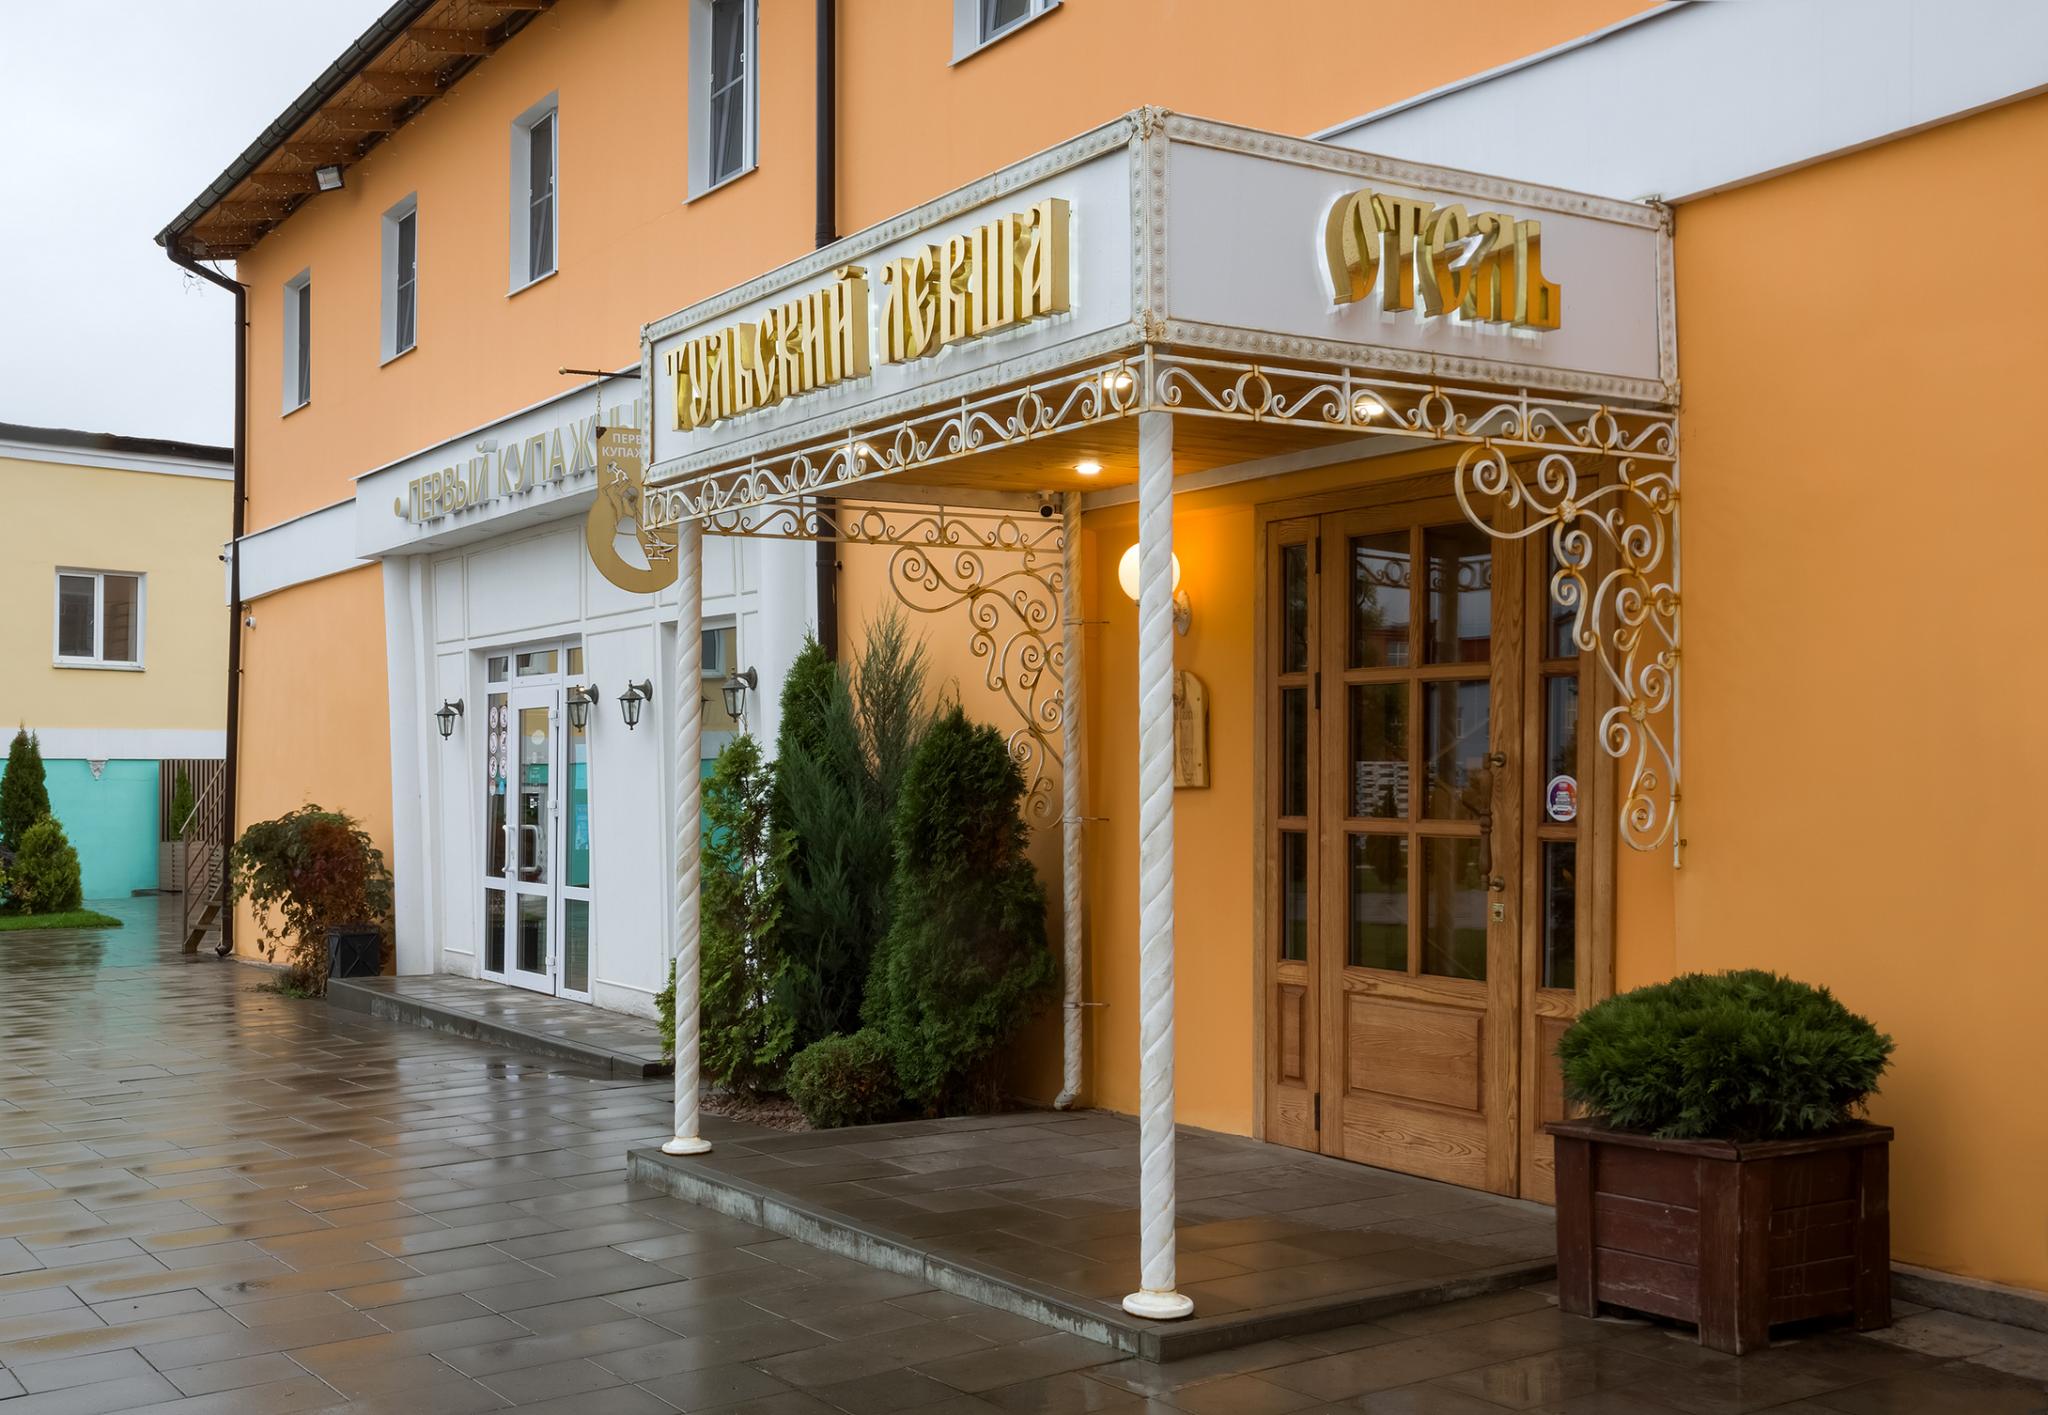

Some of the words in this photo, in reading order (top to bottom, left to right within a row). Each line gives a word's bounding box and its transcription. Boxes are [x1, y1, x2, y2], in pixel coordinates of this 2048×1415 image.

[662, 265, 870, 432] ТУЛЬСКИЙ
[879, 197, 1070, 366] ЛЕВША
[407, 439, 497, 525] ПЕРВЫЙ
